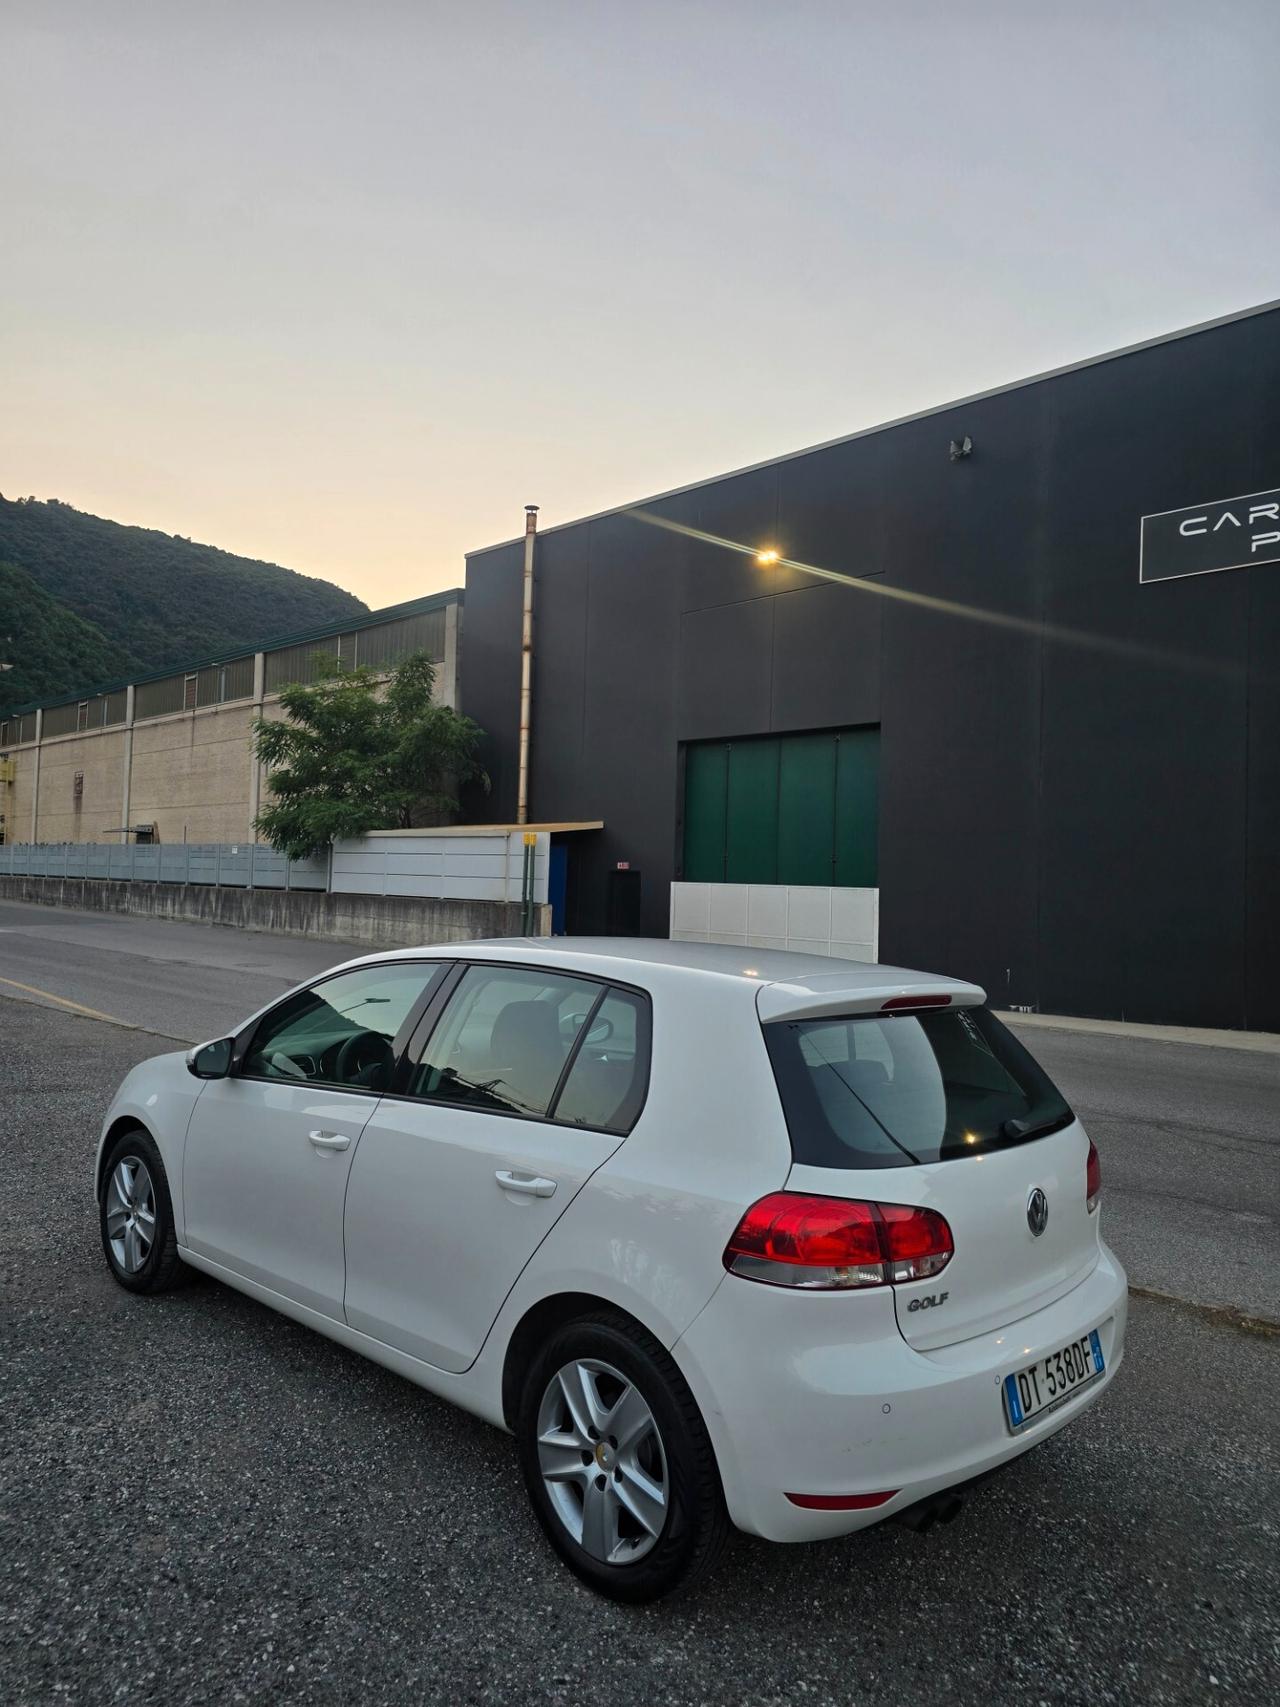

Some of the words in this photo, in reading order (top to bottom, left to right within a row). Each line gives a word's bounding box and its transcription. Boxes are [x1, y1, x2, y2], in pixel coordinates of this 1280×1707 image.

[907, 1292, 949, 1312] GOLF
[1018, 1366, 1041, 1413] DT
[1045, 1336, 1090, 1395] 538DF
